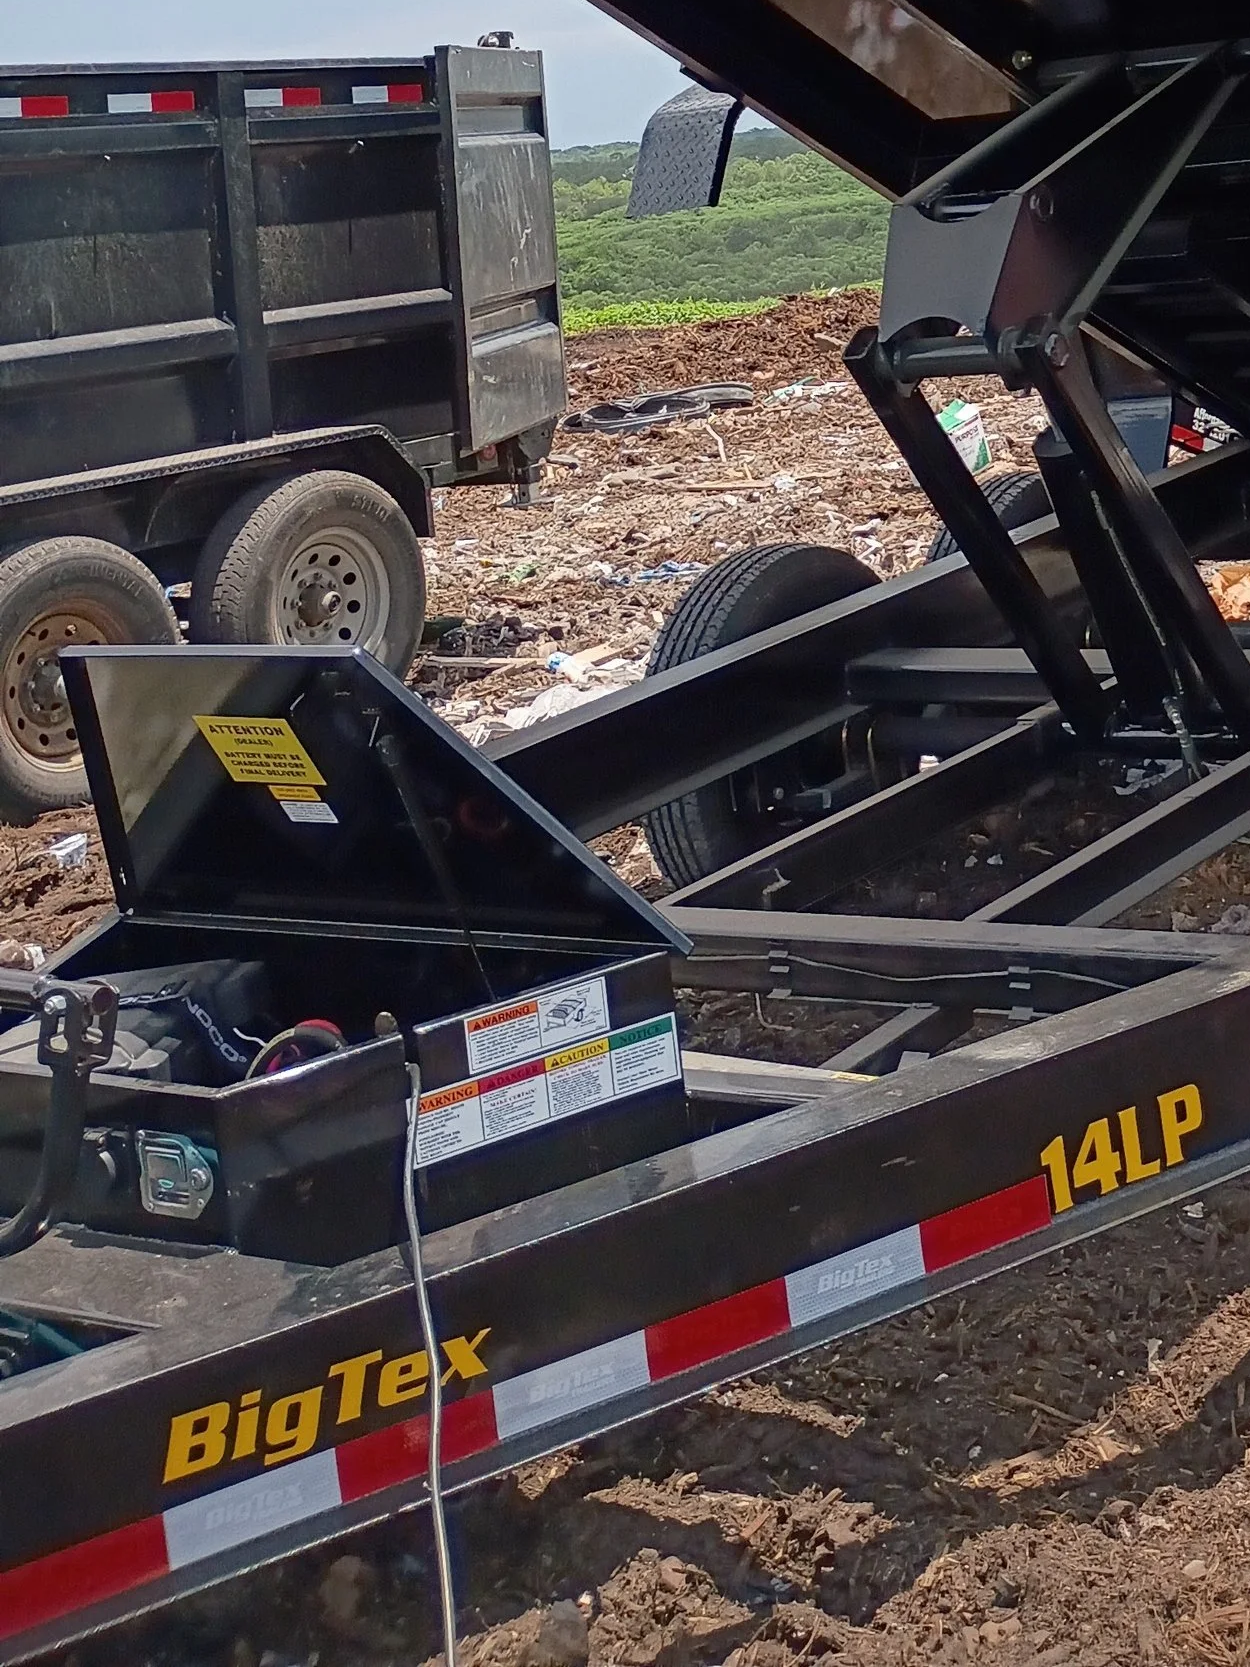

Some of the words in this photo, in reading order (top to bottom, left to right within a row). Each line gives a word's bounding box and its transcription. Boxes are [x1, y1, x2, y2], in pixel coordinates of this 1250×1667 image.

[208, 724, 285, 737] ATTENTION
[234, 738, 273, 747] (DEALER)
[224, 751, 262, 760] BATTERY
[264, 752, 288, 761] MUST
[230, 759, 271, 768] CHARGED
[272, 761, 307, 770] BEFORE
[239, 768, 264, 776] FINAL
[265, 769, 307, 778] DELIVERY
[481, 1005, 530, 1027] WARNING
[620, 1024, 664, 1043] NOTICE
[560, 1043, 604, 1063] CAUTION
[497, 1065, 539, 1086] DANGER
[1040, 1083, 1202, 1214] 14LP
[817, 1253, 896, 1294] BigTex
[528, 1361, 616, 1406] BigTex
[162, 1327, 492, 1484] BigTex
